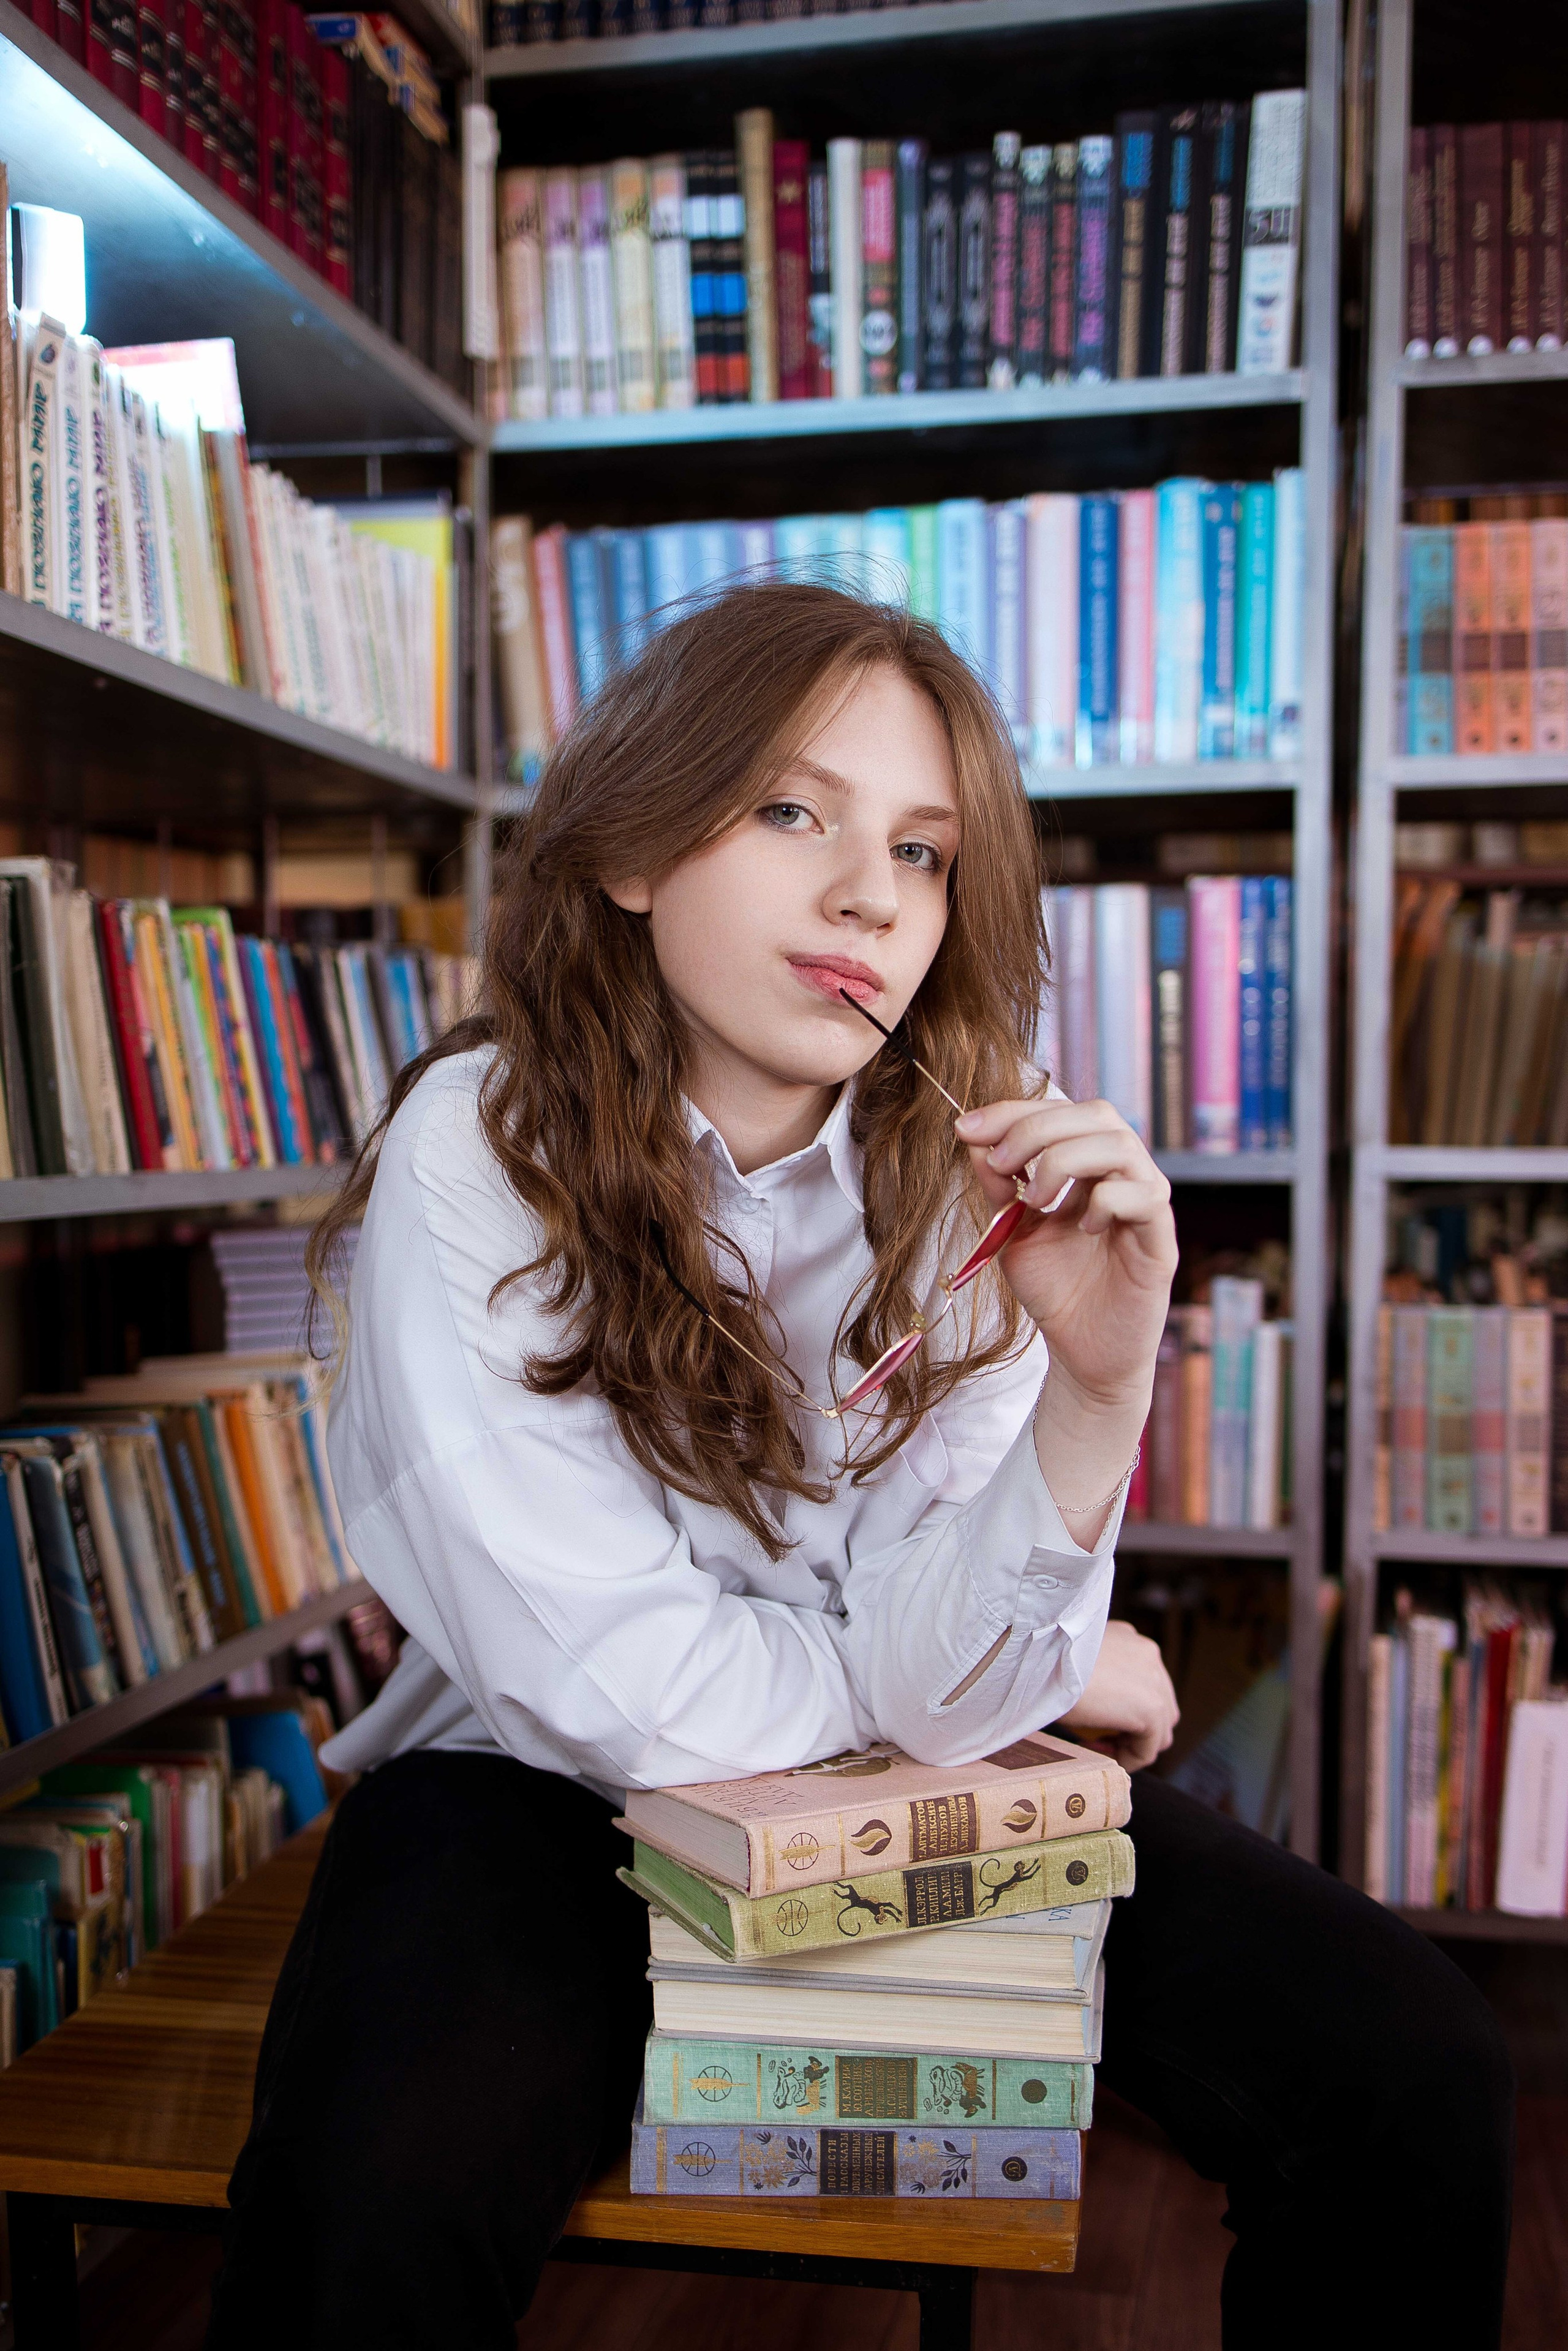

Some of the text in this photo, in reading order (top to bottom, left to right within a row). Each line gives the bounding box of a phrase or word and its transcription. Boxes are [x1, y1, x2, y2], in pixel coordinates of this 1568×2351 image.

[30, 381, 47, 453] МИР
[729, 1782, 797, 1805] ЛИТЕР
[915, 1876, 927, 1924] Л.КЭРРОЛ
[927, 1873, 940, 1923] Р.КИПЛИ
[954, 1871, 965, 1915] Дж.БАРР
[864, 2133, 873, 2194] АРУБЕЖНЫХ
